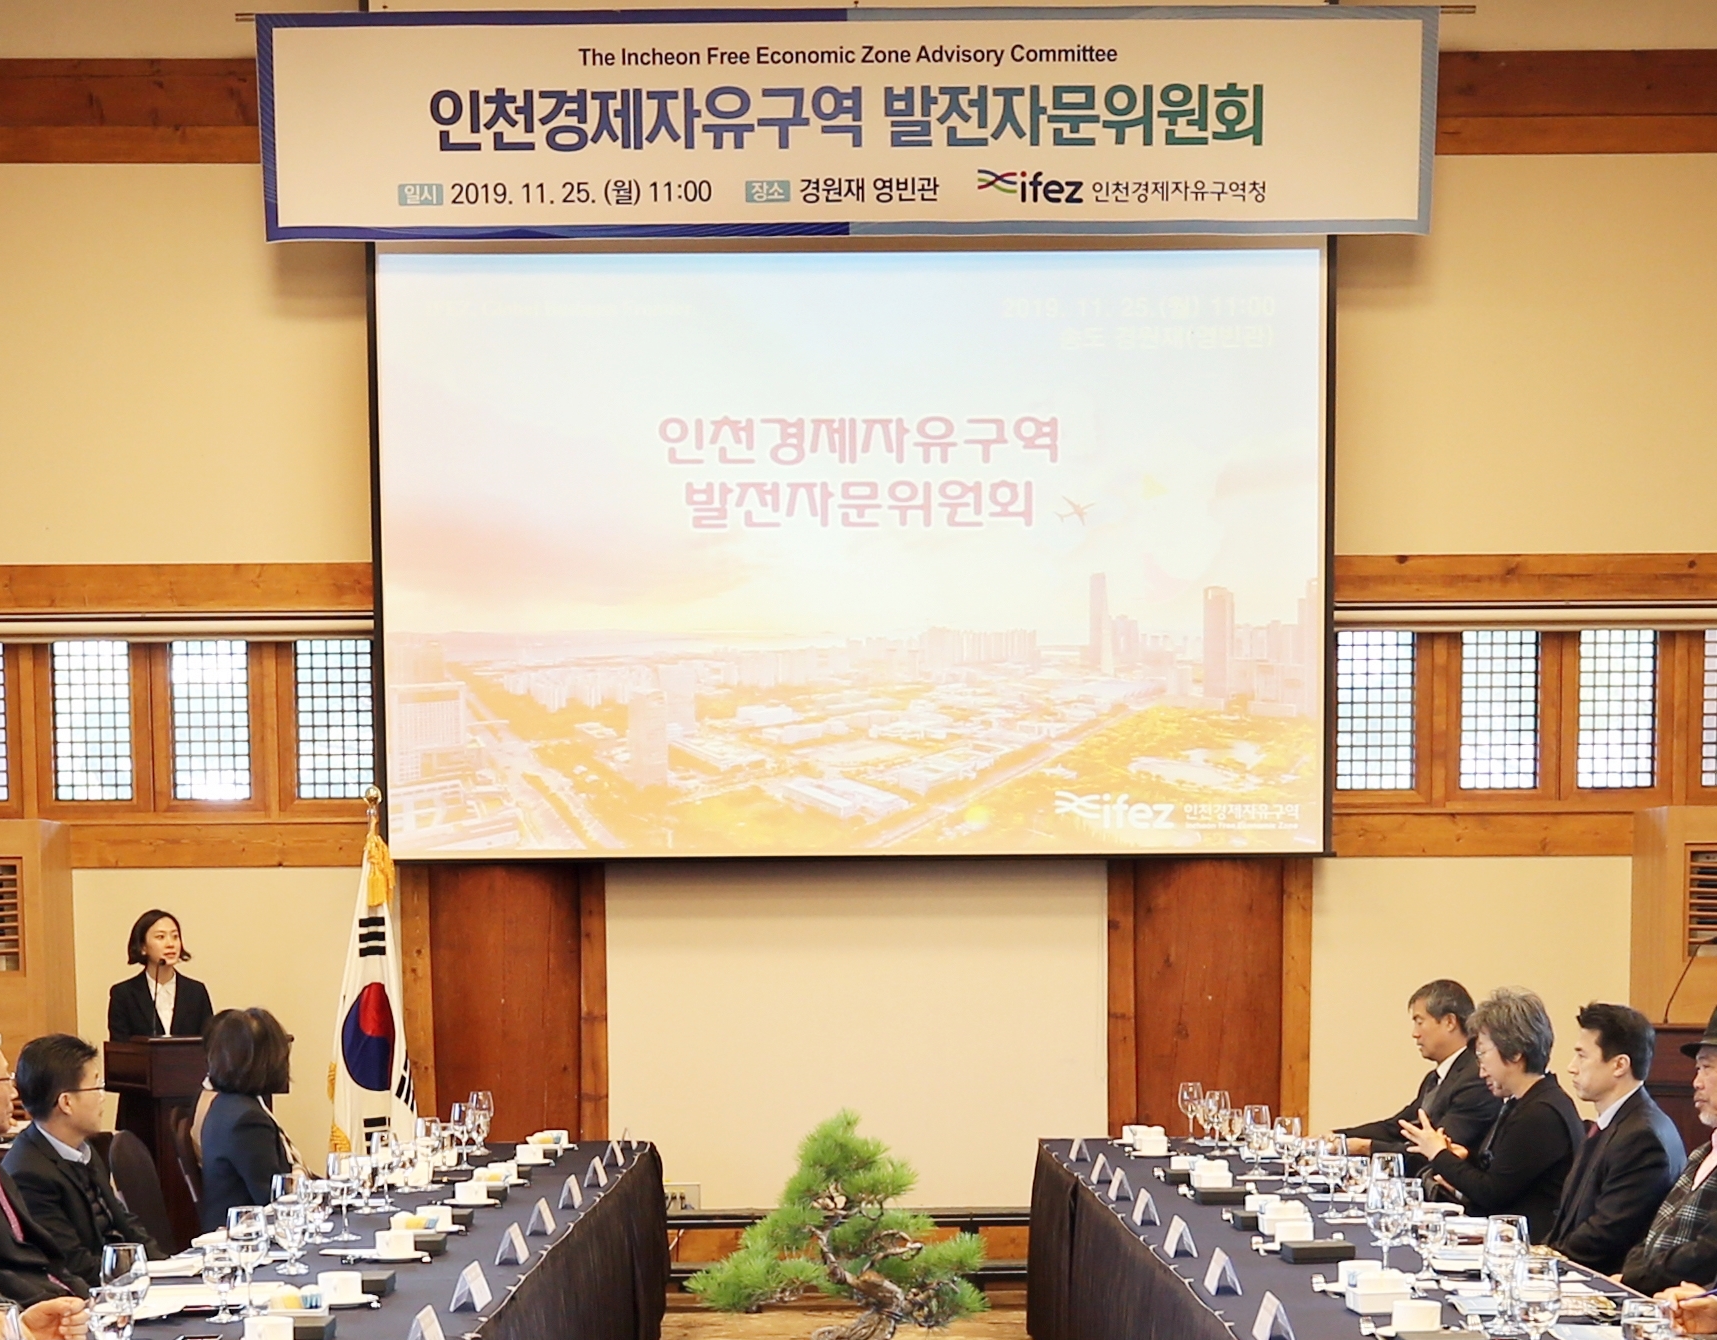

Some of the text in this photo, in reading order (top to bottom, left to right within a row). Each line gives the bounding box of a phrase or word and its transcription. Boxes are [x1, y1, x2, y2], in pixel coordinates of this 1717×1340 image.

[578, 43, 1118, 67] The Incheon Free Economic Zone Advisory Committee
[429, 82, 1264, 152] 인천경제자유구역 발전자문위원회
[404, 178, 712, 206] 일시 2019. 11. 25. (월) 11:00
[751, 176, 940, 204] 장소 경원재 영빈관
[1020, 170, 1084, 204] ifez
[1091, 179, 1266, 204] 인천경제자유구역청
[657, 415, 1060, 466] 인천경제자유구역
[684, 479, 1035, 529] 발전자문위원회
[1102, 793, 1175, 829] ifez
